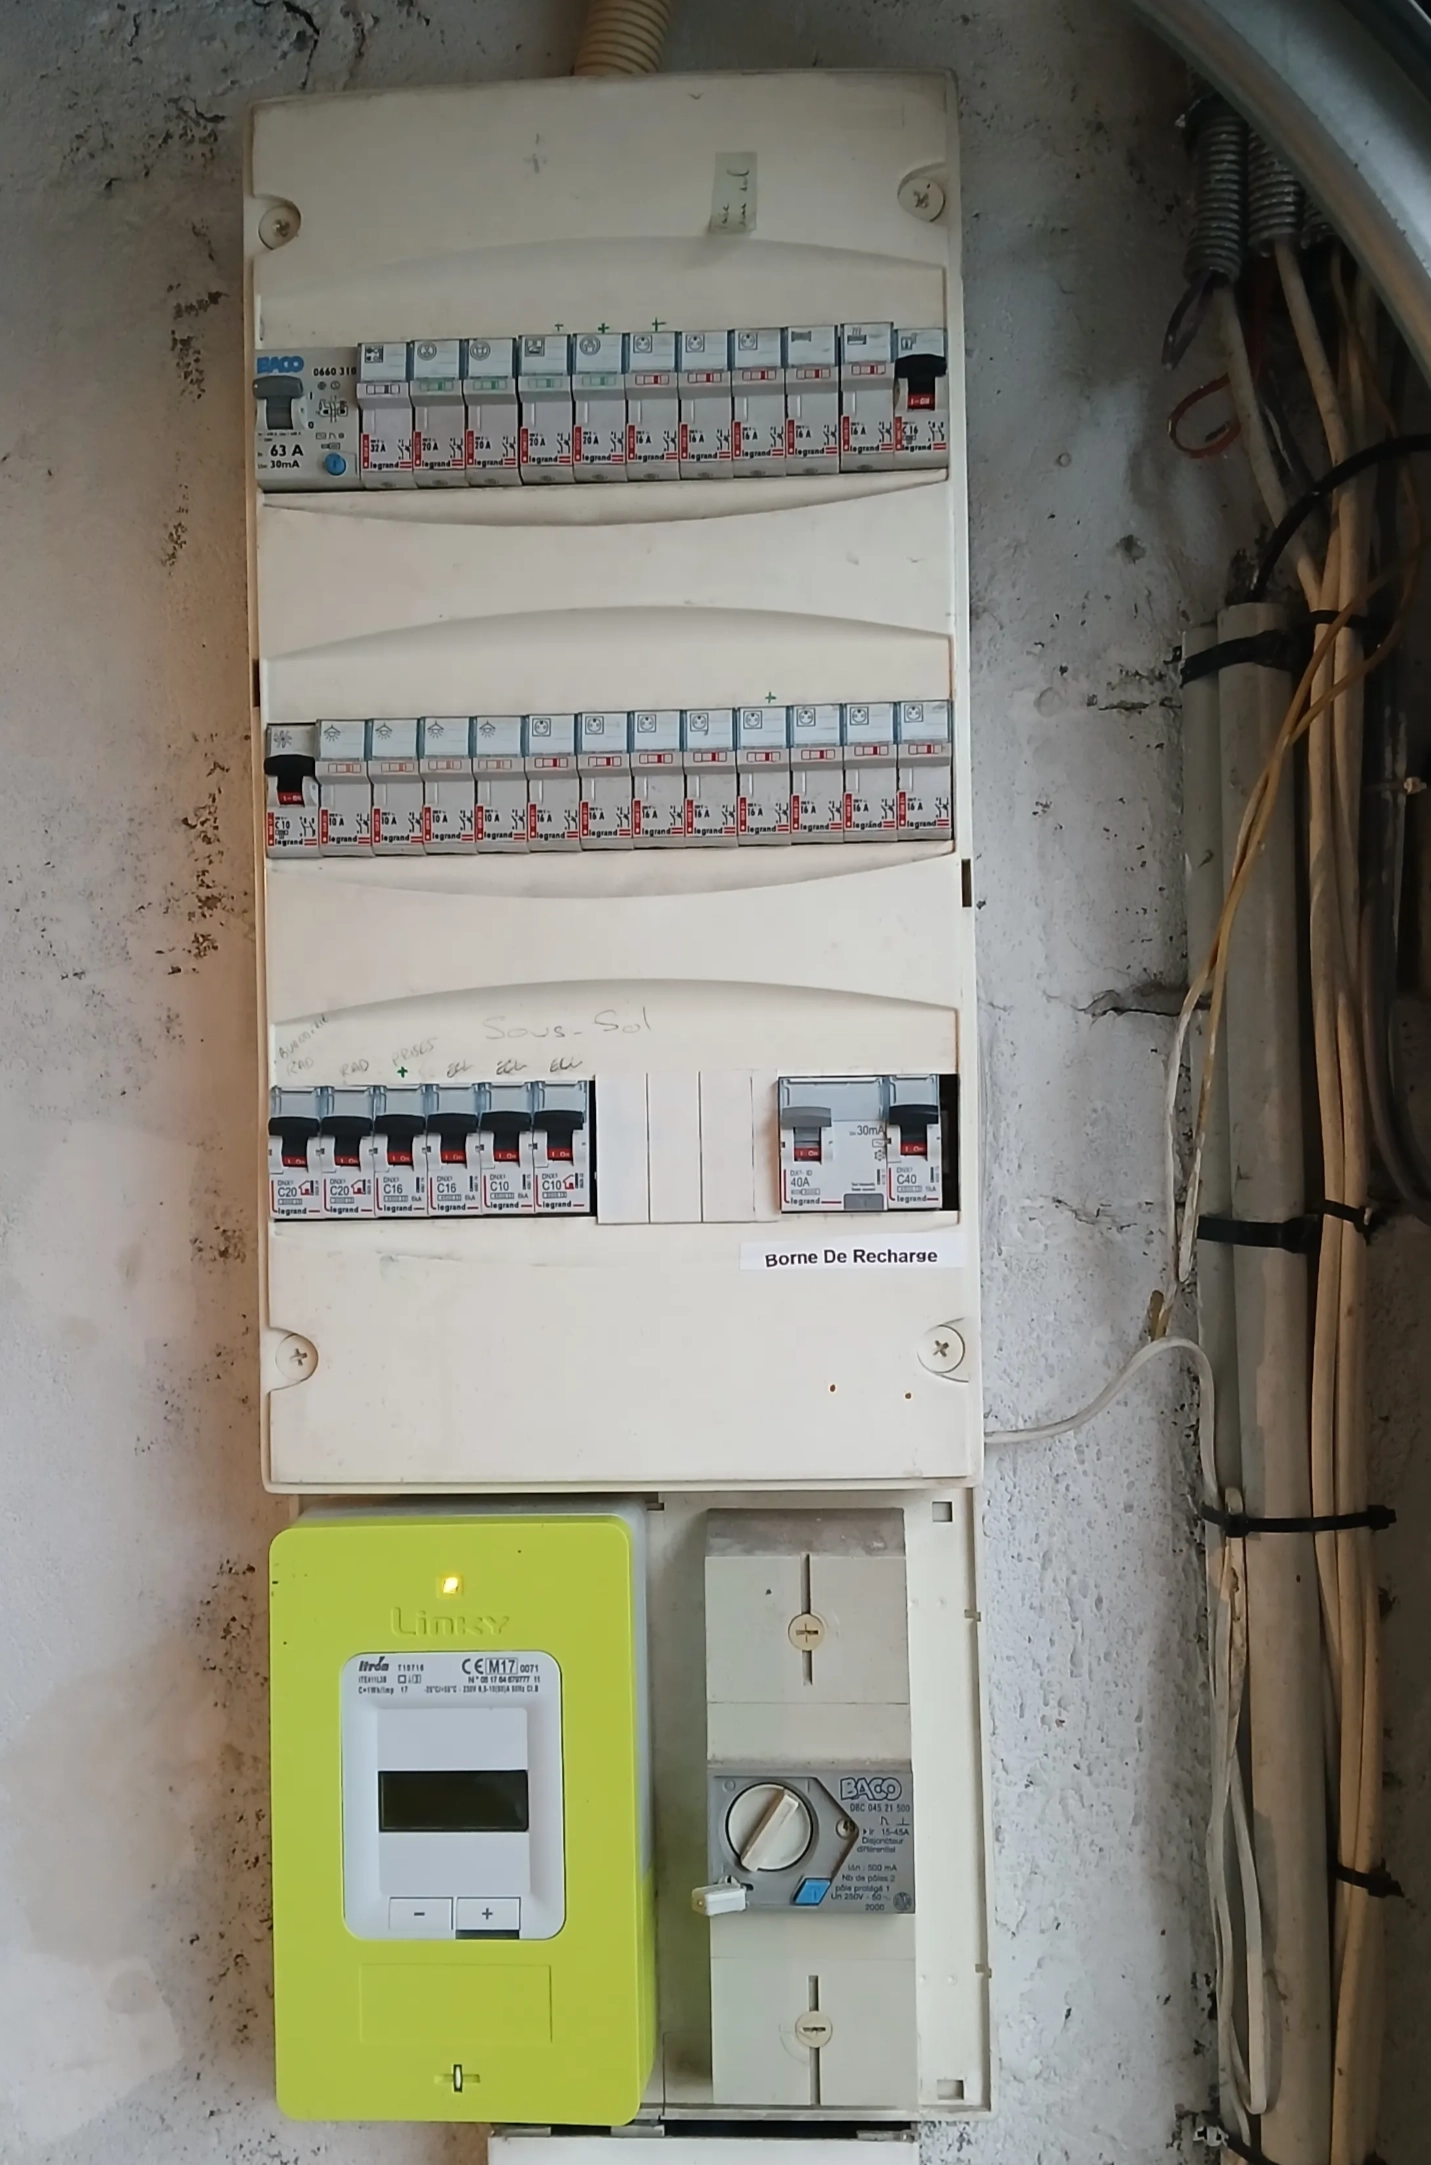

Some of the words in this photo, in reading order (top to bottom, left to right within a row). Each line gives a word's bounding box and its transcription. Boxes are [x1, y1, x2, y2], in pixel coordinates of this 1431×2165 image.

[257, 356, 304, 374] BACO
[314, 368, 336, 376] 0660
[805, 429, 811, 438] A
[860, 427, 866, 435] A
[593, 436, 599, 444] A
[645, 436, 651, 444] A
[698, 434, 704, 442] A
[751, 432, 758, 440] A
[380, 442, 386, 450] A
[432, 442, 438, 450] A
[484, 441, 491, 449] A
[539, 438, 545, 446] A
[270, 445, 286, 456] 63
[292, 444, 303, 456] A
[795, 447, 824, 456] legrand
[850, 444, 879, 453] legrand
[583, 453, 611, 462] legrand
[636, 453, 664, 461] legrand
[689, 451, 717, 460] legrand
[742, 449, 771, 458] legrand
[475, 458, 503, 466] legrand
[529, 455, 557, 464] legrand
[271, 460, 300, 468] 30mA
[370, 461, 399, 470] legrand
[422, 461, 450, 469] legrand
[757, 808, 763, 816] A
[863, 804, 869, 812] A
[442, 814, 448, 822] A
[494, 813, 500, 821] A
[546, 814, 552, 822] A
[651, 810, 657, 818] A
[704, 810, 710, 818] A
[338, 818, 344, 826] A
[391, 816, 397, 824] A
[907, 820, 936, 828] legrand
[748, 825, 776, 834] legrand
[801, 823, 829, 832] legrand
[853, 821, 882, 830] legrand
[484, 830, 512, 839] legrand
[589, 829, 617, 838] legrand
[642, 828, 670, 836] legrand
[694, 827, 722, 835] legrand
[329, 835, 357, 843] legrand
[381, 833, 409, 842] legrand
[432, 832, 461, 841] legrand
[537, 832, 565, 840] legrand
[275, 838, 303, 846] legrand
[340, 1059, 369, 1077] RAD
[857, 1125, 885, 1136] 30mA
[790, 1177, 810, 1187] 40A
[897, 1174, 916, 1184] C40
[384, 1184, 403, 1194] C16
[437, 1183, 456, 1193] C16
[490, 1182, 509, 1191] C10
[542, 1180, 561, 1190] C10
[278, 1187, 297, 1197] C20
[330, 1186, 349, 1196] C20
[791, 1198, 820, 1206] legrand
[897, 1195, 926, 1203] legrand
[330, 1206, 359, 1214] legrand
[438, 1204, 466, 1212] legrand
[490, 1202, 519, 1210] legrand
[765, 1253, 818, 1267] Borne
[824, 1250, 847, 1264] De
[853, 1249, 938, 1266] Recharge
[462, 1658, 484, 1675] CE
[489, 1659, 515, 1673] M17
[520, 1664, 538, 1673] 0071
[840, 1777, 902, 1801] BACO
[885, 1804, 892, 1812] 21
[897, 1804, 910, 1812] 500
